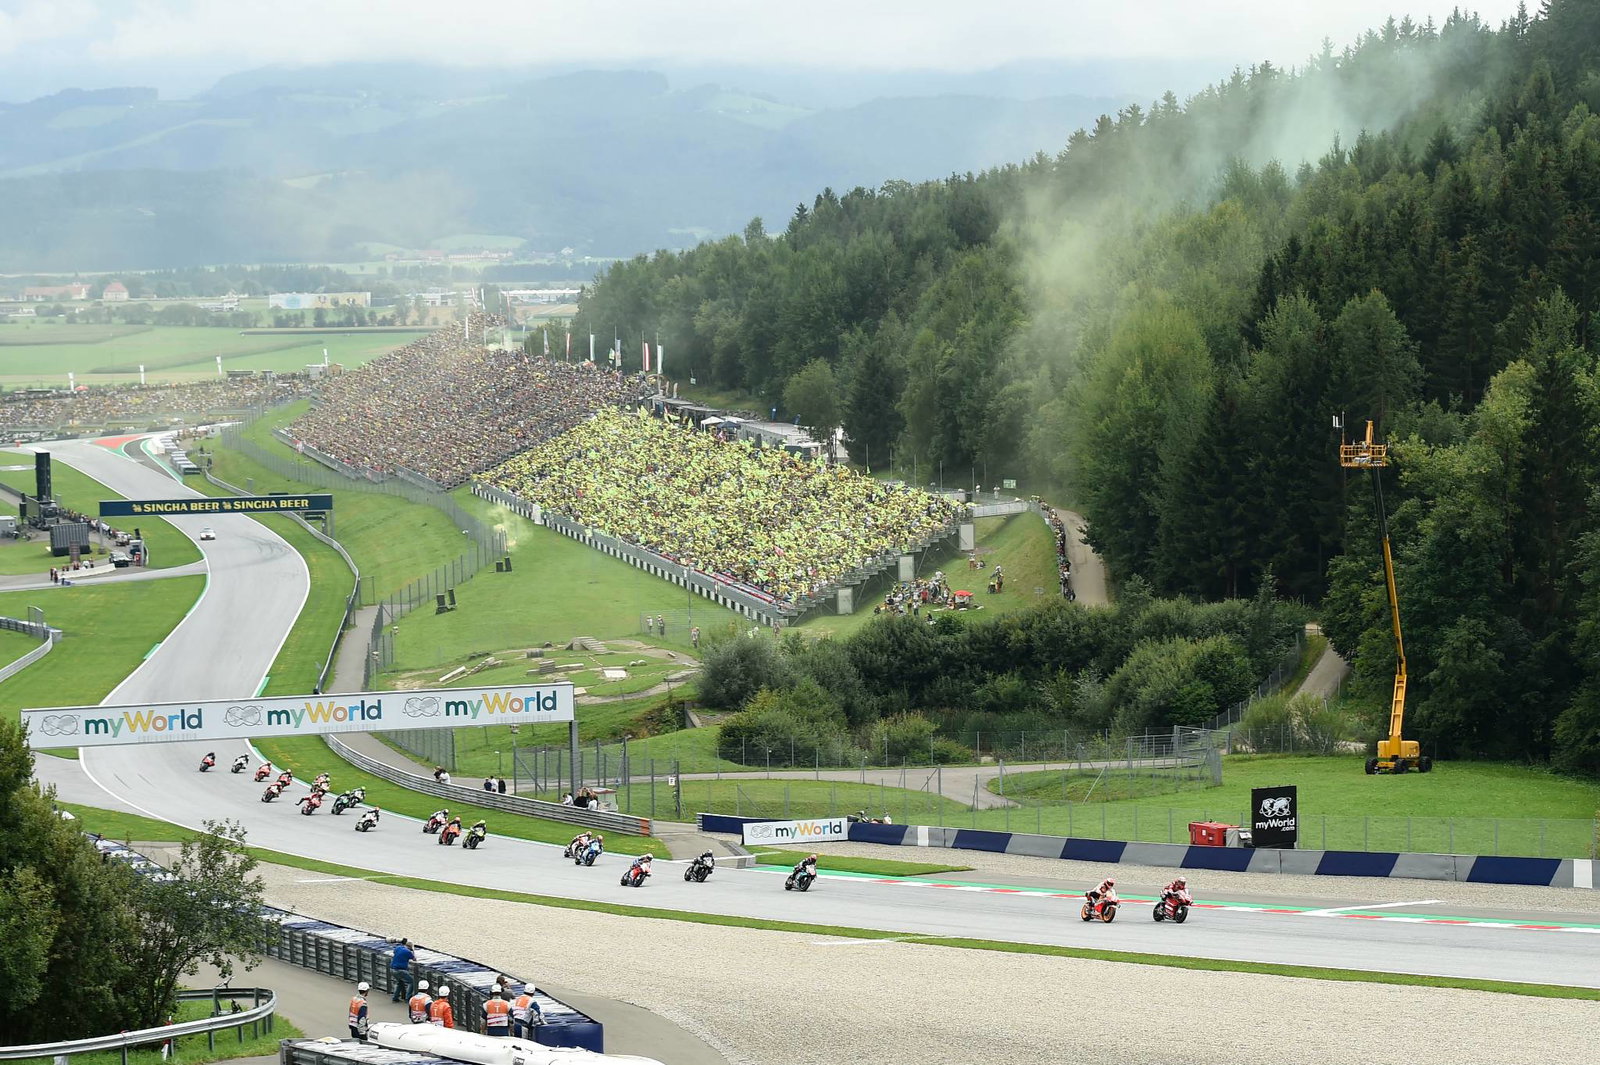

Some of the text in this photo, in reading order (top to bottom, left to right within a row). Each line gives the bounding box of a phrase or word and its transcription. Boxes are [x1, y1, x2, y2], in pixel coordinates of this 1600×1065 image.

[143, 502, 220, 513] SINGHA BEER
[233, 499, 309, 510] SINGHA BEER
[267, 699, 382, 728] myWorld
[445, 690, 557, 719] myWorld
[84, 708, 203, 738] myWorld
[775, 821, 842, 839] myWorld
[1255, 817, 1295, 830] myWorld
